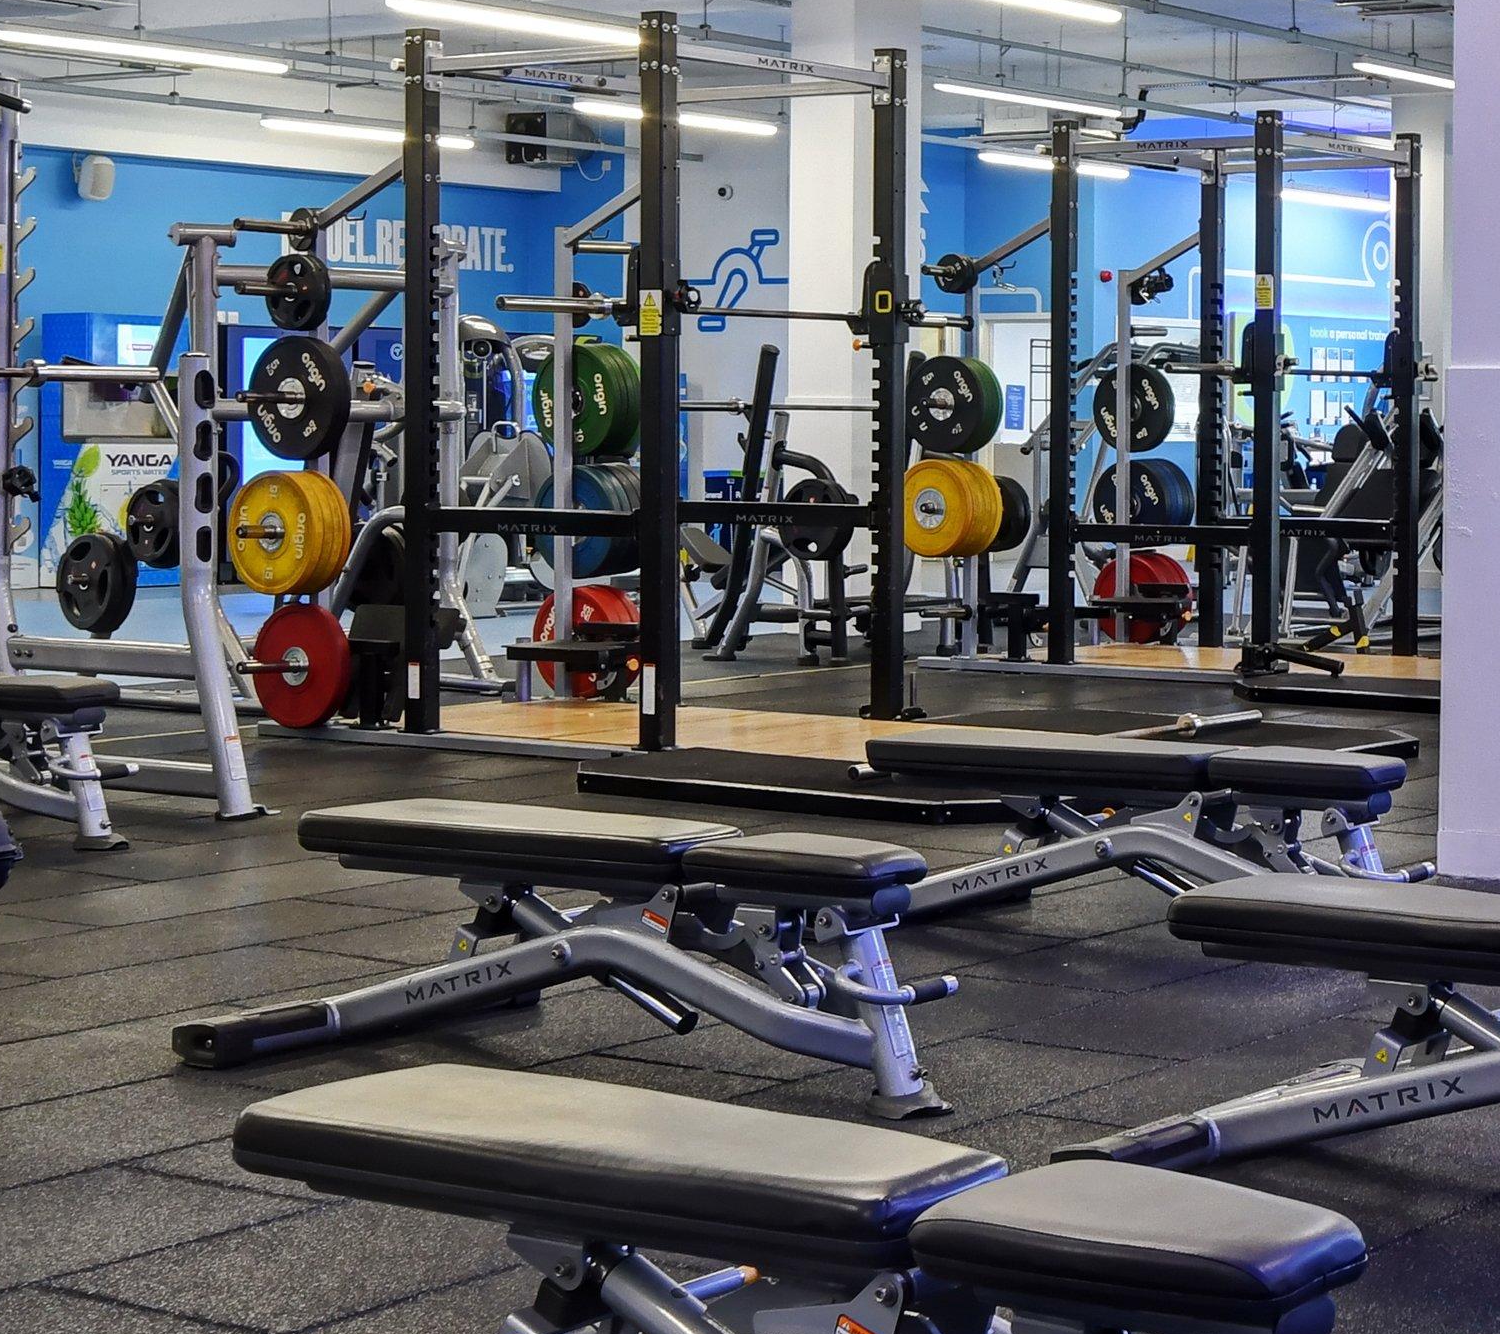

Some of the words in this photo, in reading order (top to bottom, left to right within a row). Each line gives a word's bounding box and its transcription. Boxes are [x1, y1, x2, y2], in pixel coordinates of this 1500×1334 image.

[525, 69, 584, 83] MATRIX
[758, 57, 814, 73] MATRIX
[1137, 140, 1189, 150] MATRIX
[1328, 143, 1362, 153] MATRIX
[301, 352, 326, 392] origin
[953, 370, 975, 403] origin
[594, 373, 607, 415] origin
[1141, 378, 1160, 410] origin
[257, 404, 282, 443] origin
[106, 454, 172, 467] YANGA
[1140, 473, 1160, 505] origin
[497, 523, 557, 533] MATRIX
[736, 515, 793, 524] MATRIX
[952, 857, 1049, 894] MATRIX
[406, 960, 512, 1005] MATRIX
[1313, 1076, 1464, 1124] MATRIX
